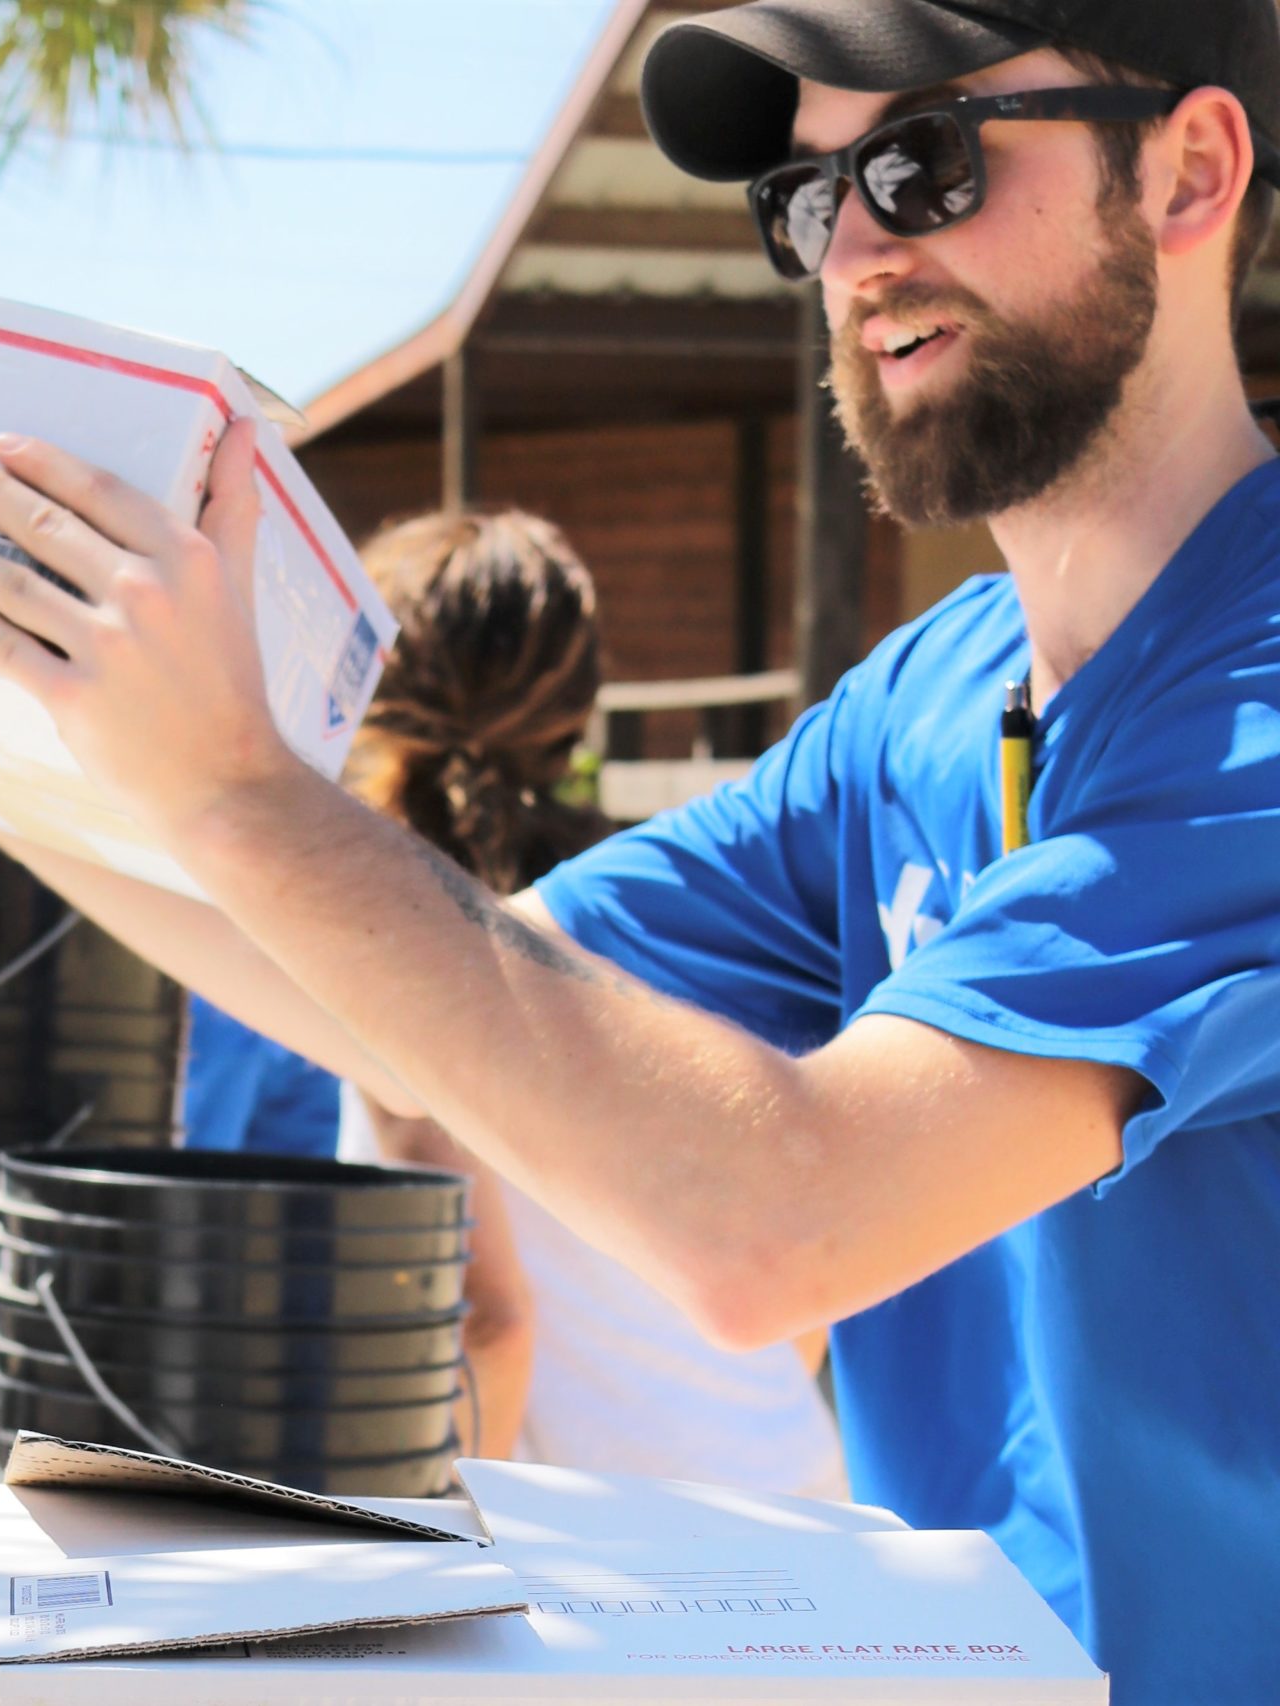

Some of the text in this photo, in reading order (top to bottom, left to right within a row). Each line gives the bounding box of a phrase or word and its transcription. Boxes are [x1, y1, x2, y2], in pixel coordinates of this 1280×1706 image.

[727, 1645, 1024, 1654] LARGE FLAT RATE BOX
